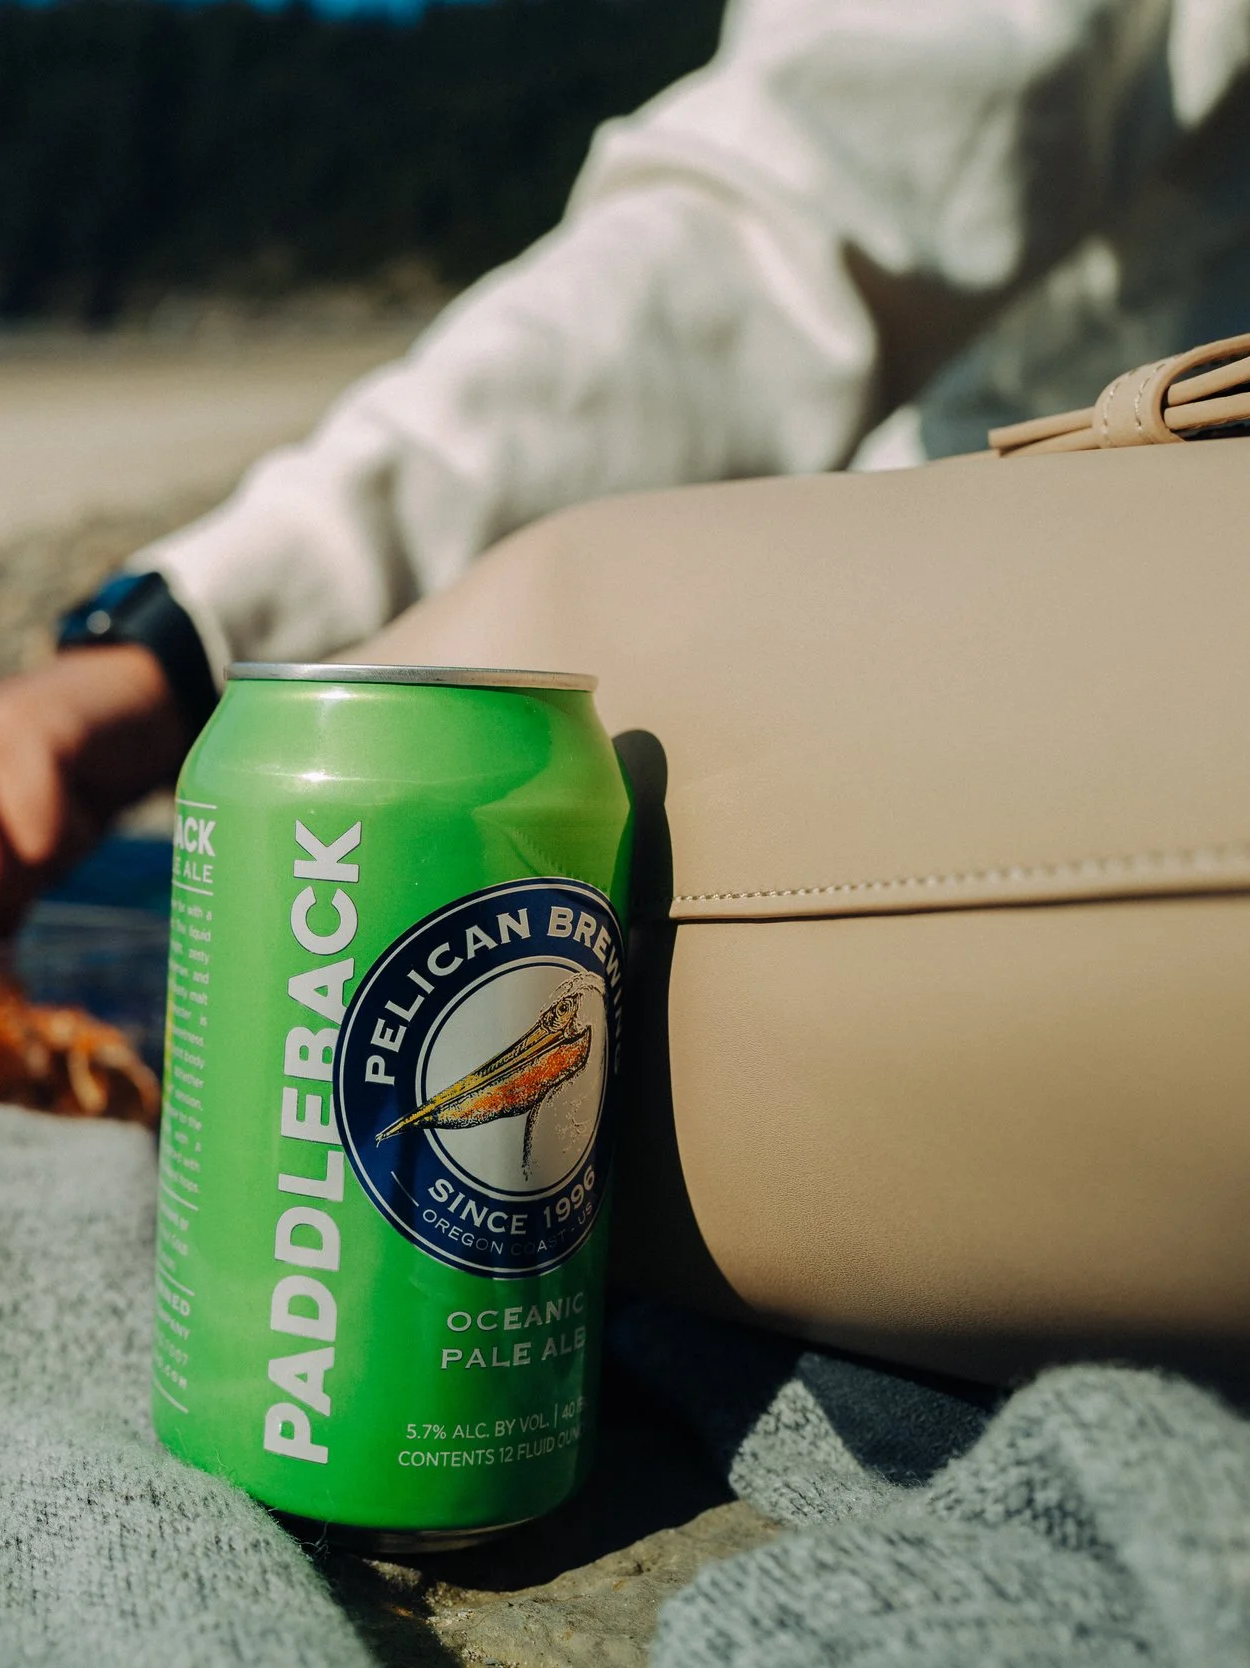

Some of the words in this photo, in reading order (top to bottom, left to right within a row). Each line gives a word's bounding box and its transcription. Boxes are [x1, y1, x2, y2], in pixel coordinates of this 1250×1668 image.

[183, 859, 214, 885] ALE
[364, 906, 532, 1087] PELICAN
[262, 819, 362, 1465] PADDLEBACK
[427, 1178, 528, 1236] SINCE
[543, 1164, 595, 1229] 1996
[422, 1208, 504, 1255] OREGON
[510, 1228, 567, 1257] COAST
[446, 1292, 584, 1333] OCEANIC
[440, 1341, 532, 1371] PALE
[541, 1325, 586, 1361] ALE
[405, 1423, 447, 1441] 5.7%
[452, 1422, 490, 1440] ALC.
[494, 1418, 516, 1438] BY
[519, 1413, 550, 1433] VOL.
[561, 1400, 575, 1420] 40
[397, 1448, 495, 1468] CONTENTS
[498, 1445, 514, 1464] 12
[517, 1435, 556, 1461] FLUID
